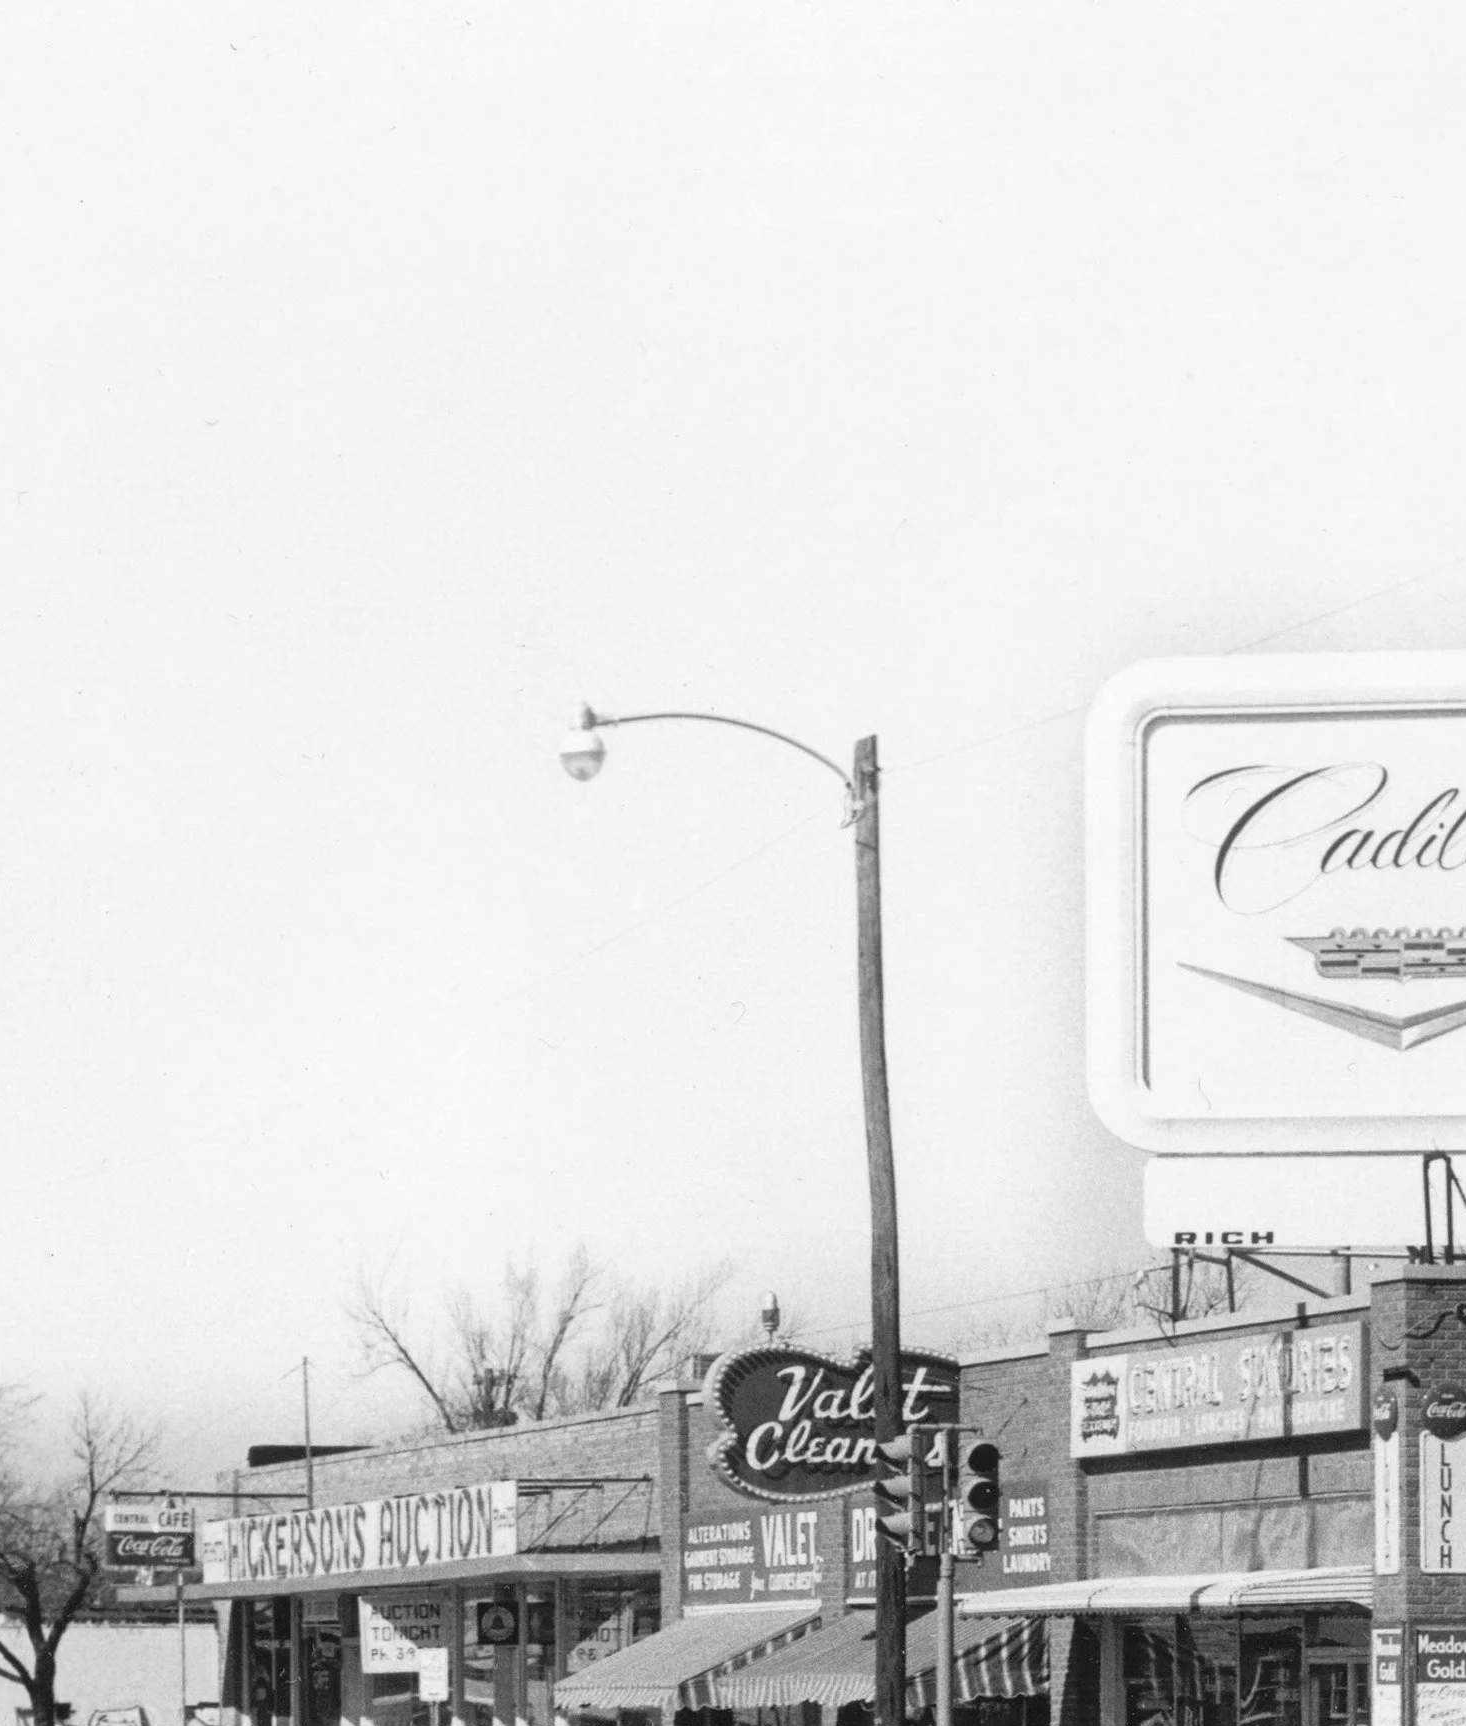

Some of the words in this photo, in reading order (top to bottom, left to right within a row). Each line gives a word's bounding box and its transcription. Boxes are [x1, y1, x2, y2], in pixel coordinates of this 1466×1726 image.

[1173, 1231, 1276, 1247] RICH
[777, 1364, 951, 1421] Valt
[746, 1420, 944, 1470] Cleans
[157, 1511, 190, 1528] CAFE
[1440, 1443, 1453, 1570] LUNCH
[379, 1486, 492, 1566] AUCTION
[760, 1511, 818, 1568] VALET
[370, 1603, 442, 1621] AUCTION
[370, 1624, 442, 1643] TONIGHT
[1426, 1659, 1466, 1680] Gold
